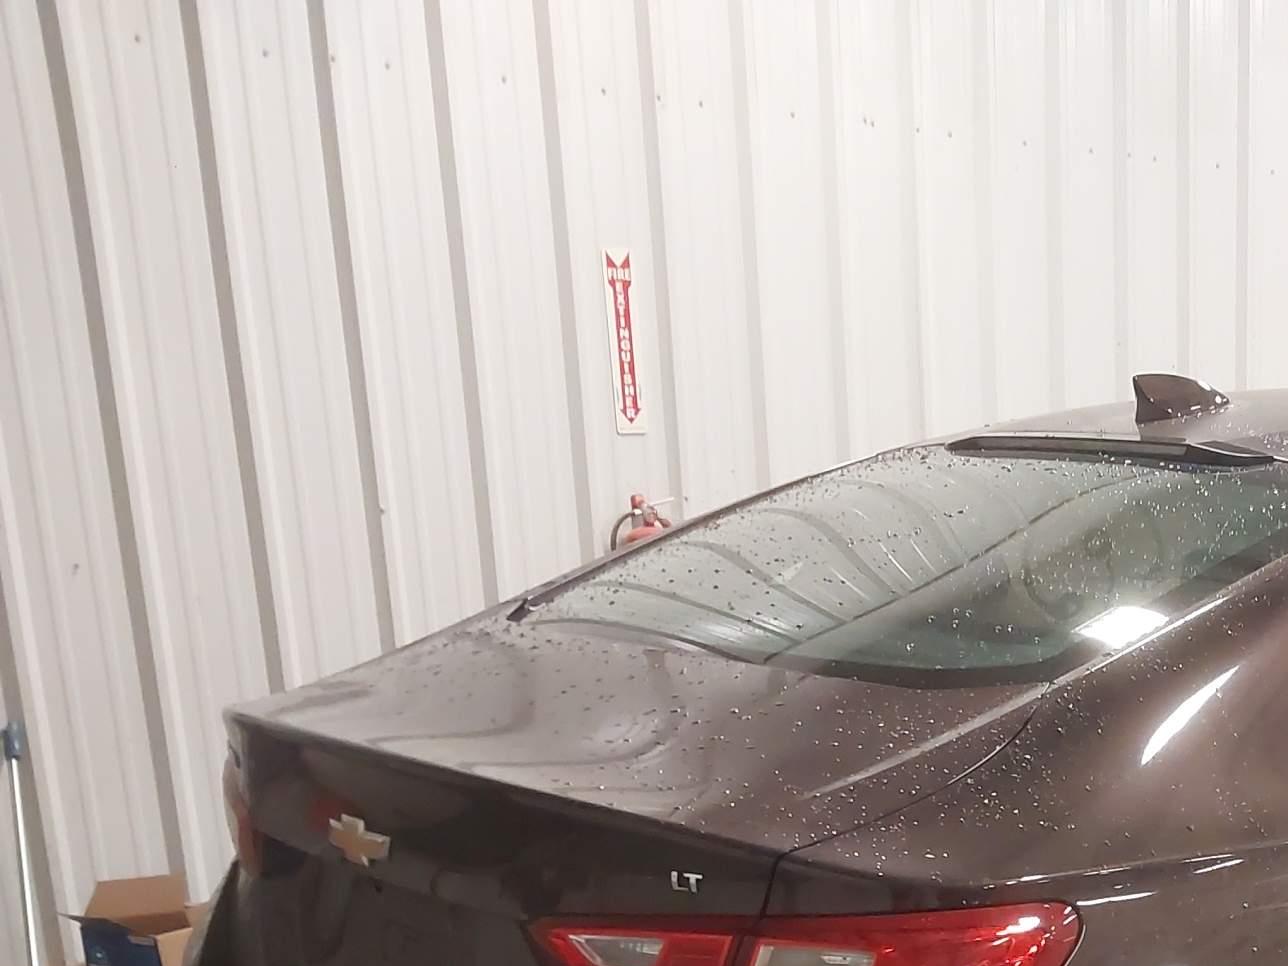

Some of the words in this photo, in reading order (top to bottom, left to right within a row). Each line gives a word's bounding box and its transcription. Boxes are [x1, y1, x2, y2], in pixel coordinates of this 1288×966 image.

[607, 266, 632, 281] FIRE
[614, 280, 637, 418] EXTINGUISHER
[671, 870, 704, 894] LT
